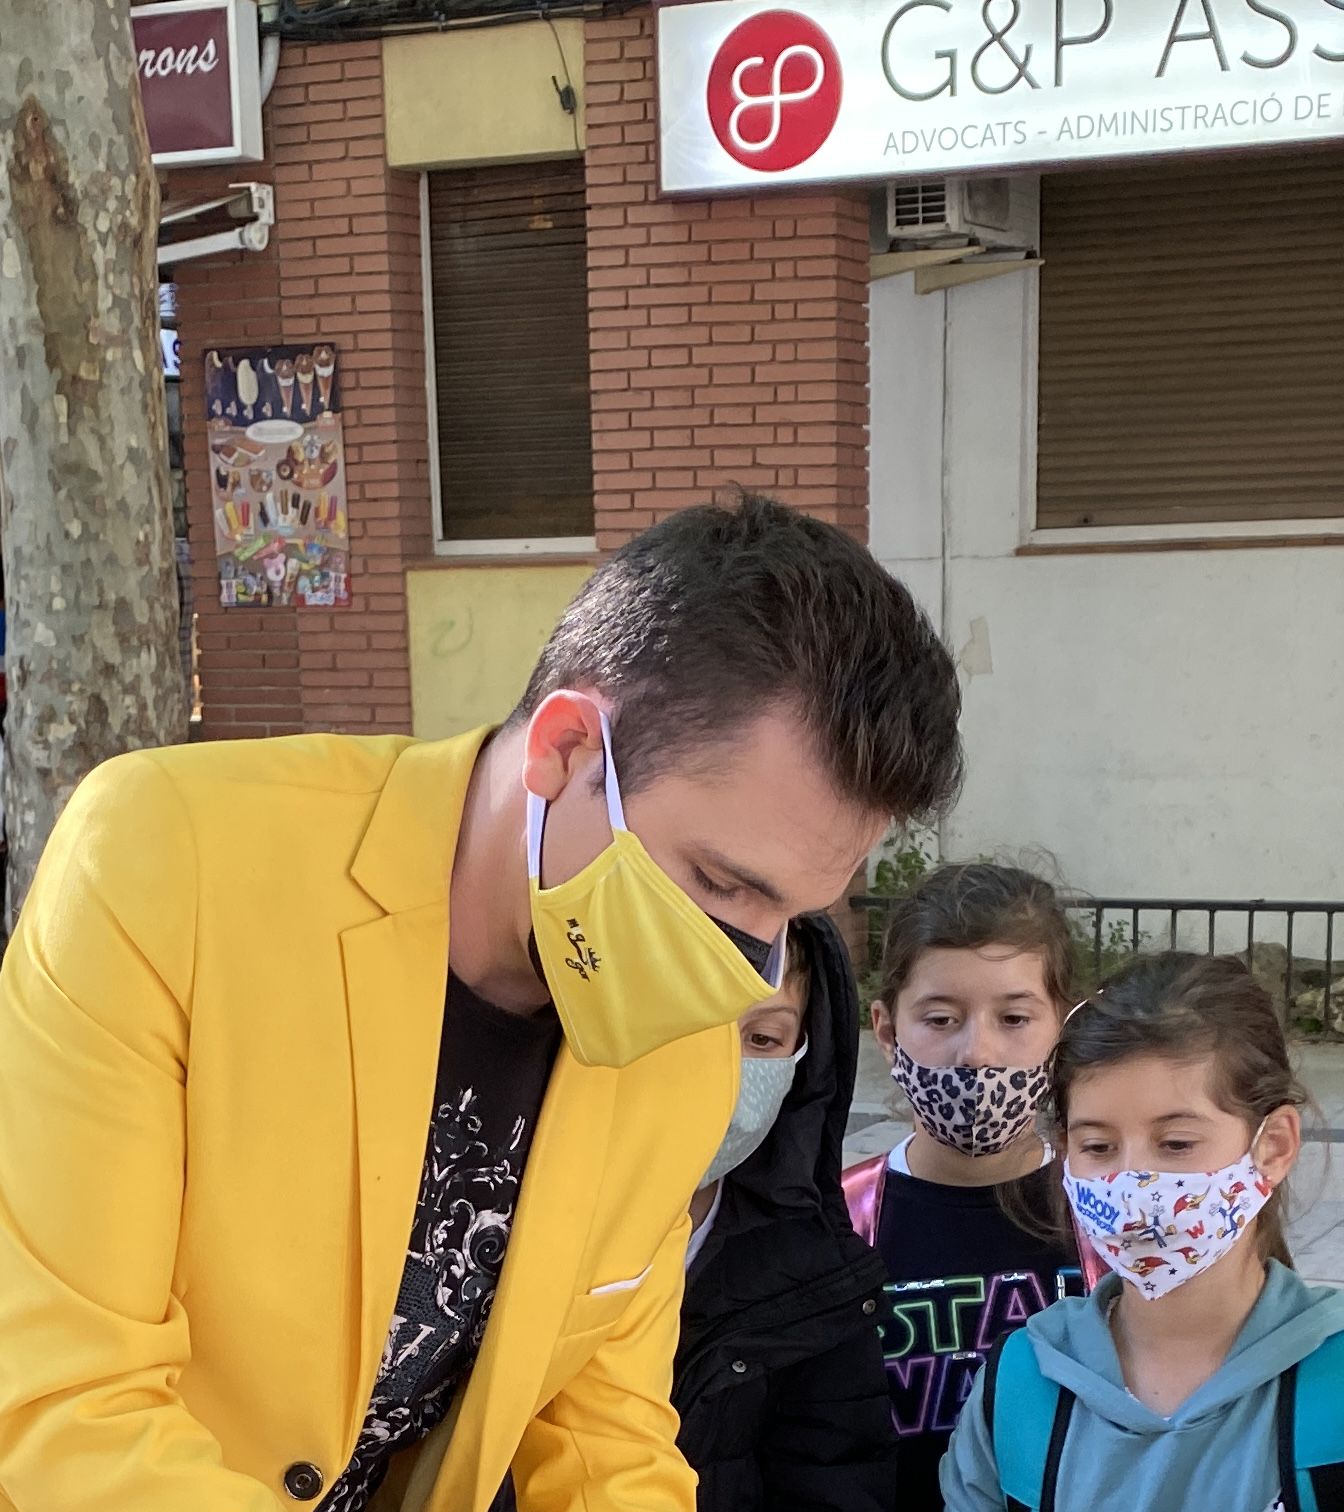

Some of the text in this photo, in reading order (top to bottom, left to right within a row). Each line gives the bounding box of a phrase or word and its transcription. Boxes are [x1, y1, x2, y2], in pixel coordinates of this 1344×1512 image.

[881, 0, 1115, 101] G&P
[883, 120, 1027, 157] ADVOCATS
[1057, 92, 1283, 143] ADMINISTRACIÓ
[1294, 94, 1331, 121] DE
[1076, 1181, 1120, 1226] WOODY
